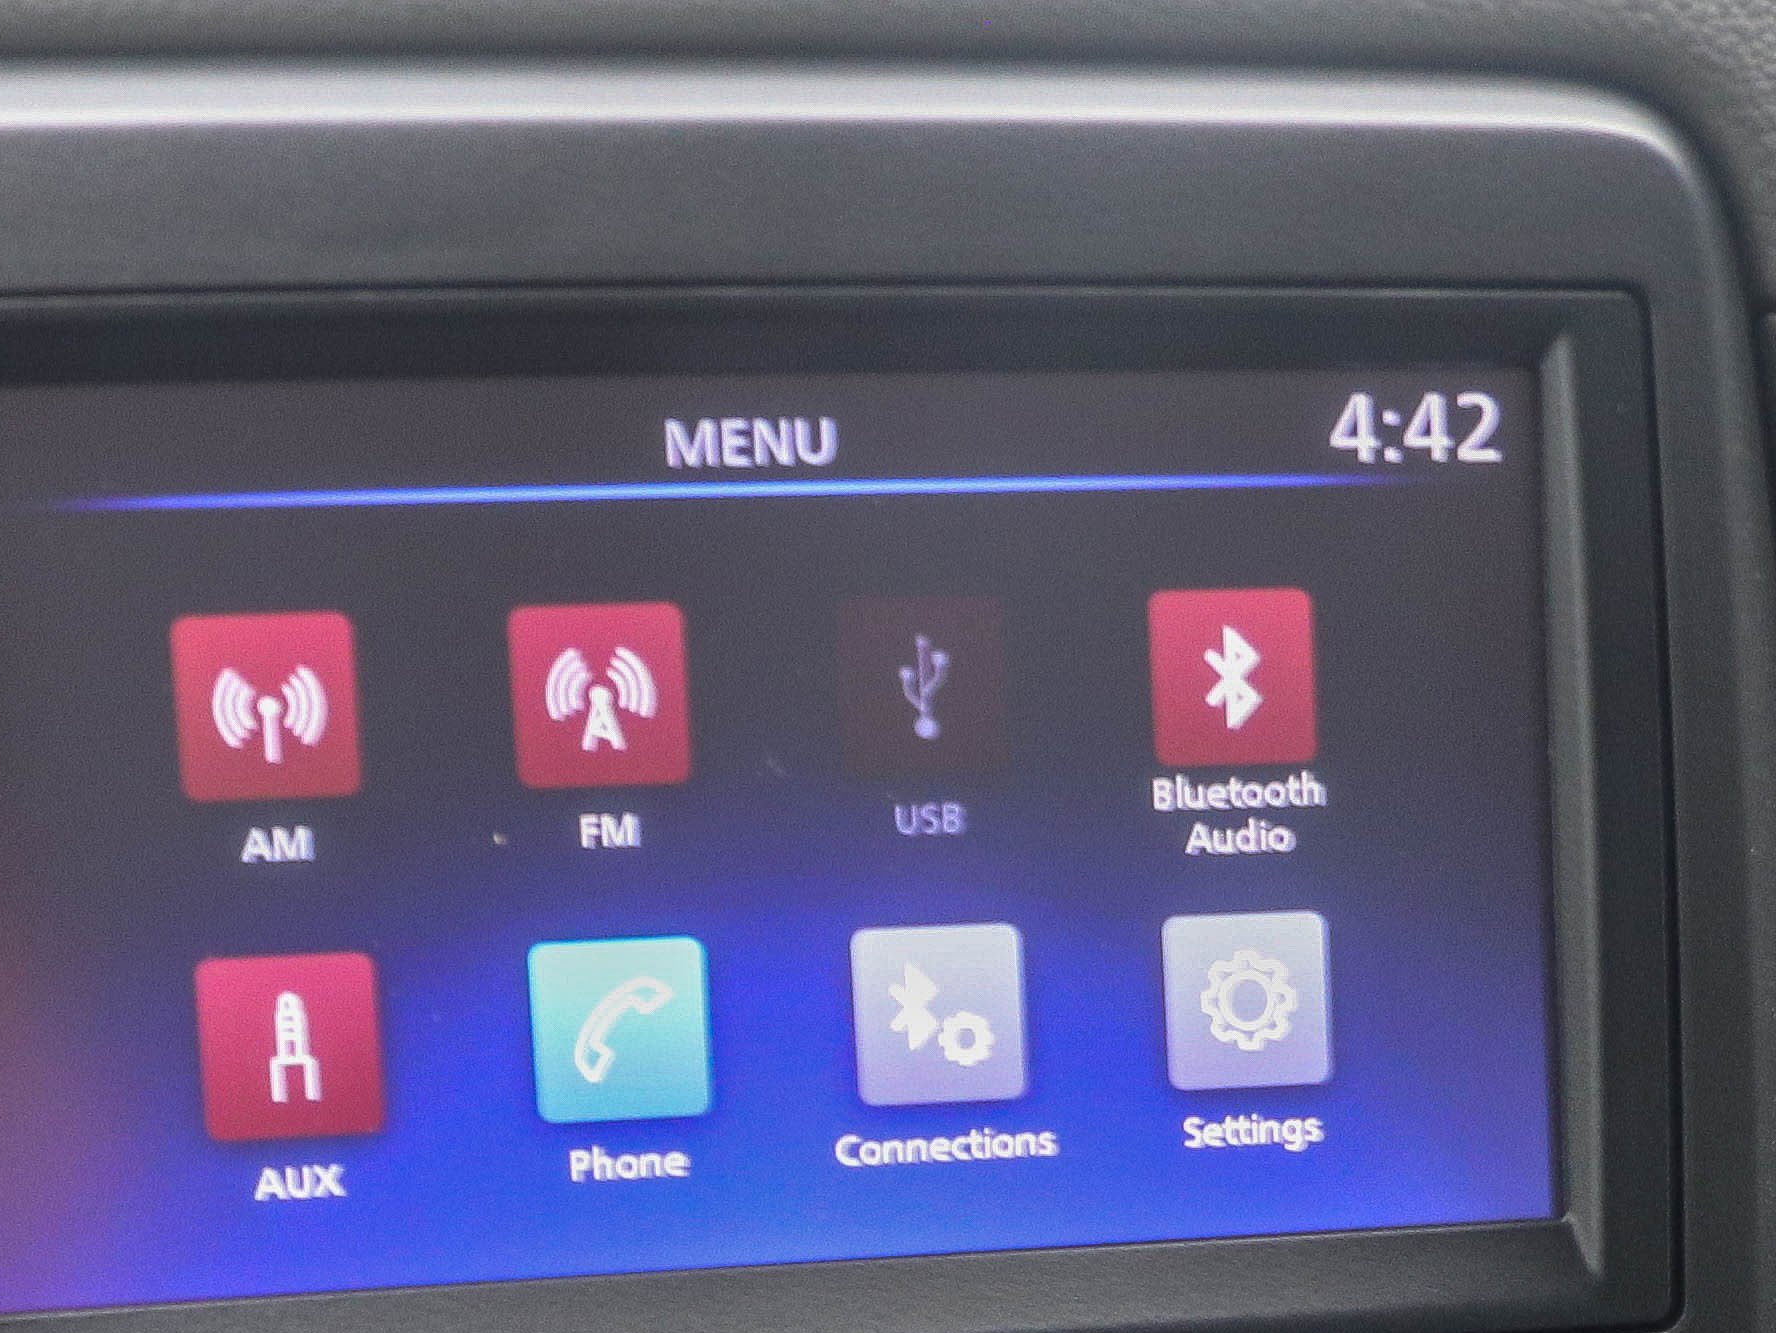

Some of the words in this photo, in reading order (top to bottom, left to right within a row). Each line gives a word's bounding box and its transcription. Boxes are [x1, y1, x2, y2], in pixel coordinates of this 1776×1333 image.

[664, 415, 838, 470] MENU
[1329, 390, 1504, 465] 4:42
[1152, 770, 1327, 811] Bluetooth
[579, 812, 641, 849] FM
[895, 803, 966, 836] USB
[1184, 818, 1296, 856] Audio
[240, 826, 315, 863] AM
[835, 1128, 1060, 1168] Connections
[1183, 1114, 1325, 1152] Settings
[254, 1164, 347, 1201] AUX
[569, 1145, 692, 1183] Phone
